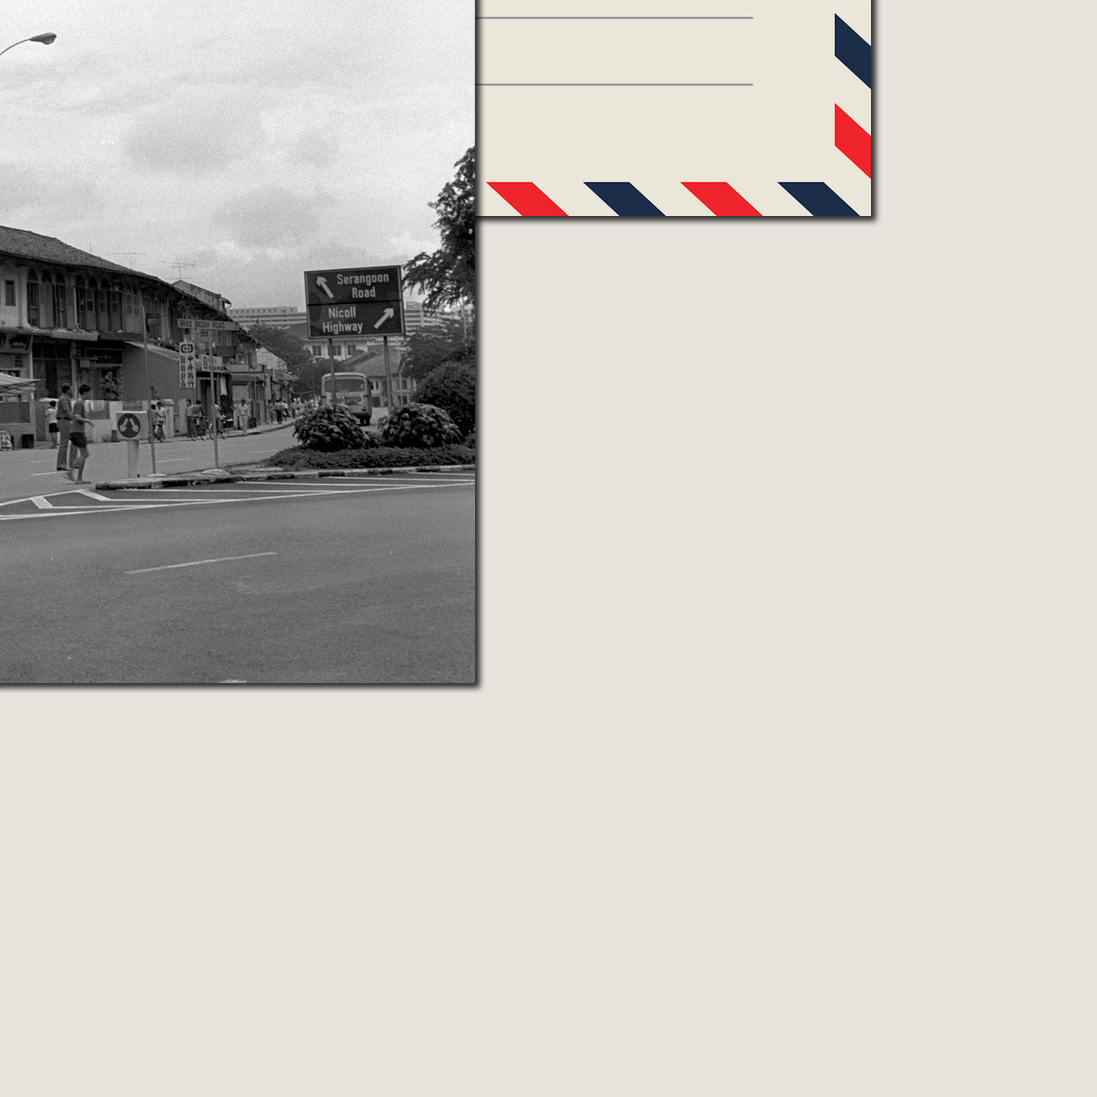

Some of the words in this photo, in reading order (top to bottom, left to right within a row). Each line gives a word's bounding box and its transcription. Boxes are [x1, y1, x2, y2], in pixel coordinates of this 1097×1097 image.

[336, 273, 390, 286] Serangoon
[351, 286, 376, 299] Road
[328, 306, 356, 319] Nicoll
[322, 322, 363, 335] Highway
